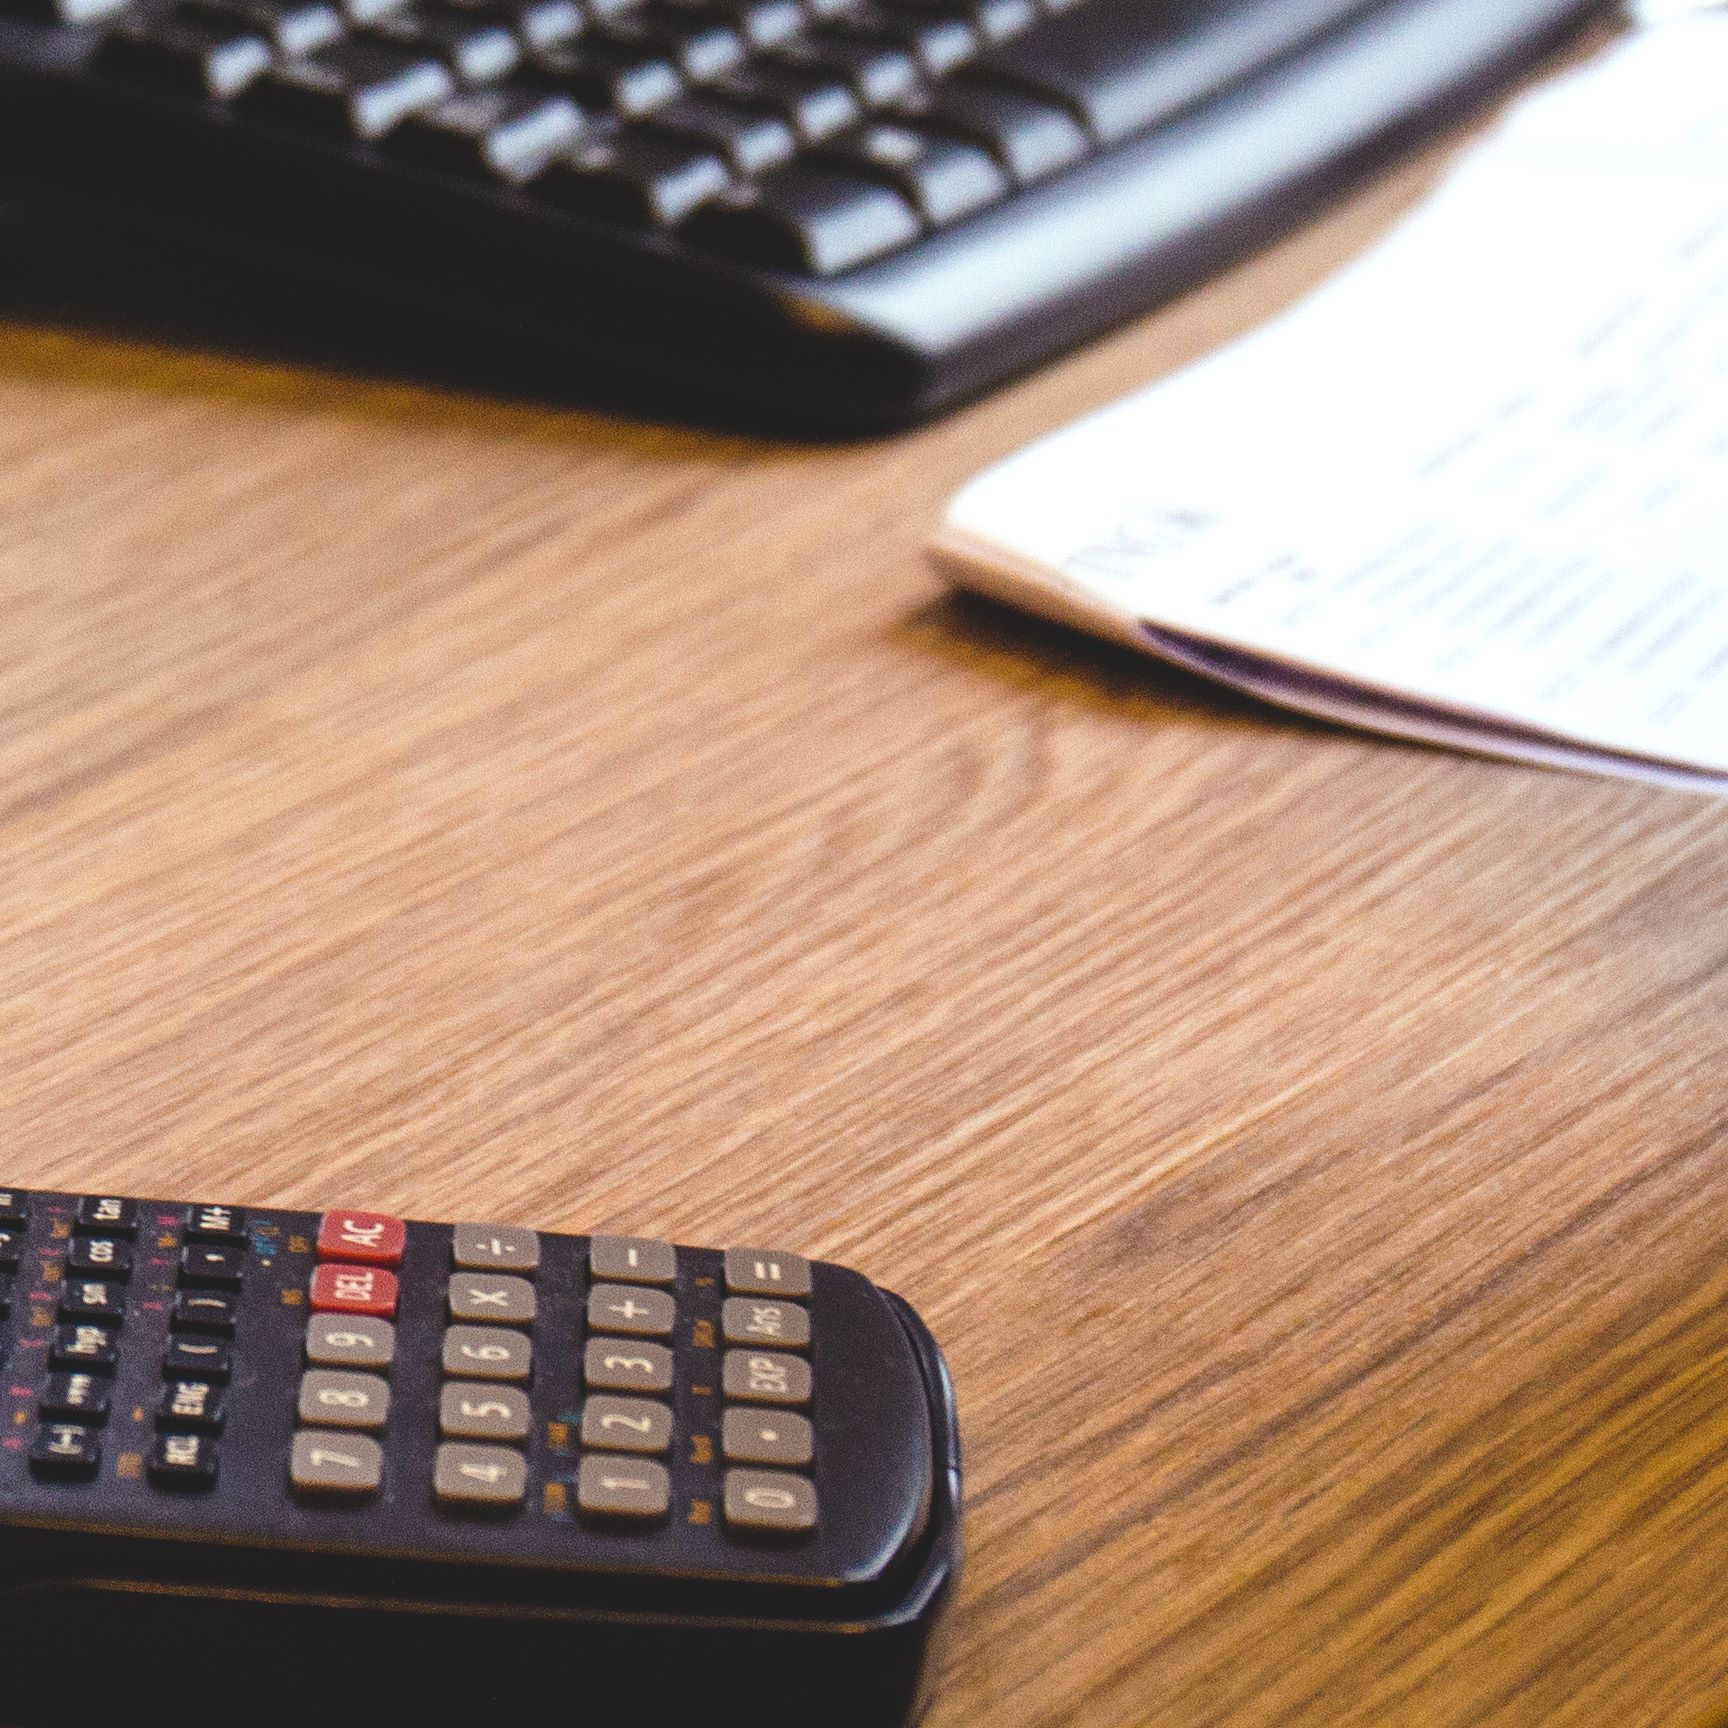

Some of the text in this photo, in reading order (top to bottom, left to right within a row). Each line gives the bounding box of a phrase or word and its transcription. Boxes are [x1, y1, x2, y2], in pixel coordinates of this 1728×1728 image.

[340, 1218, 384, 1248] AC
[335, 1271, 374, 1302] DEL
[745, 1305, 782, 1337] Ans
[324, 1331, 374, 1348] 9
[461, 1342, 510, 1361] 6
[603, 1355, 654, 1373] 3
[749, 1356, 788, 1393] EXP
[171, 1381, 209, 1417] ENG
[318, 1387, 369, 1408] 8
[461, 1399, 512, 1419] 5
[600, 1412, 652, 1433] 2
[310, 1448, 361, 1468] 7
[458, 1462, 509, 1483] 4
[600, 1476, 651, 1490] 1
[744, 1487, 795, 1509] 0
